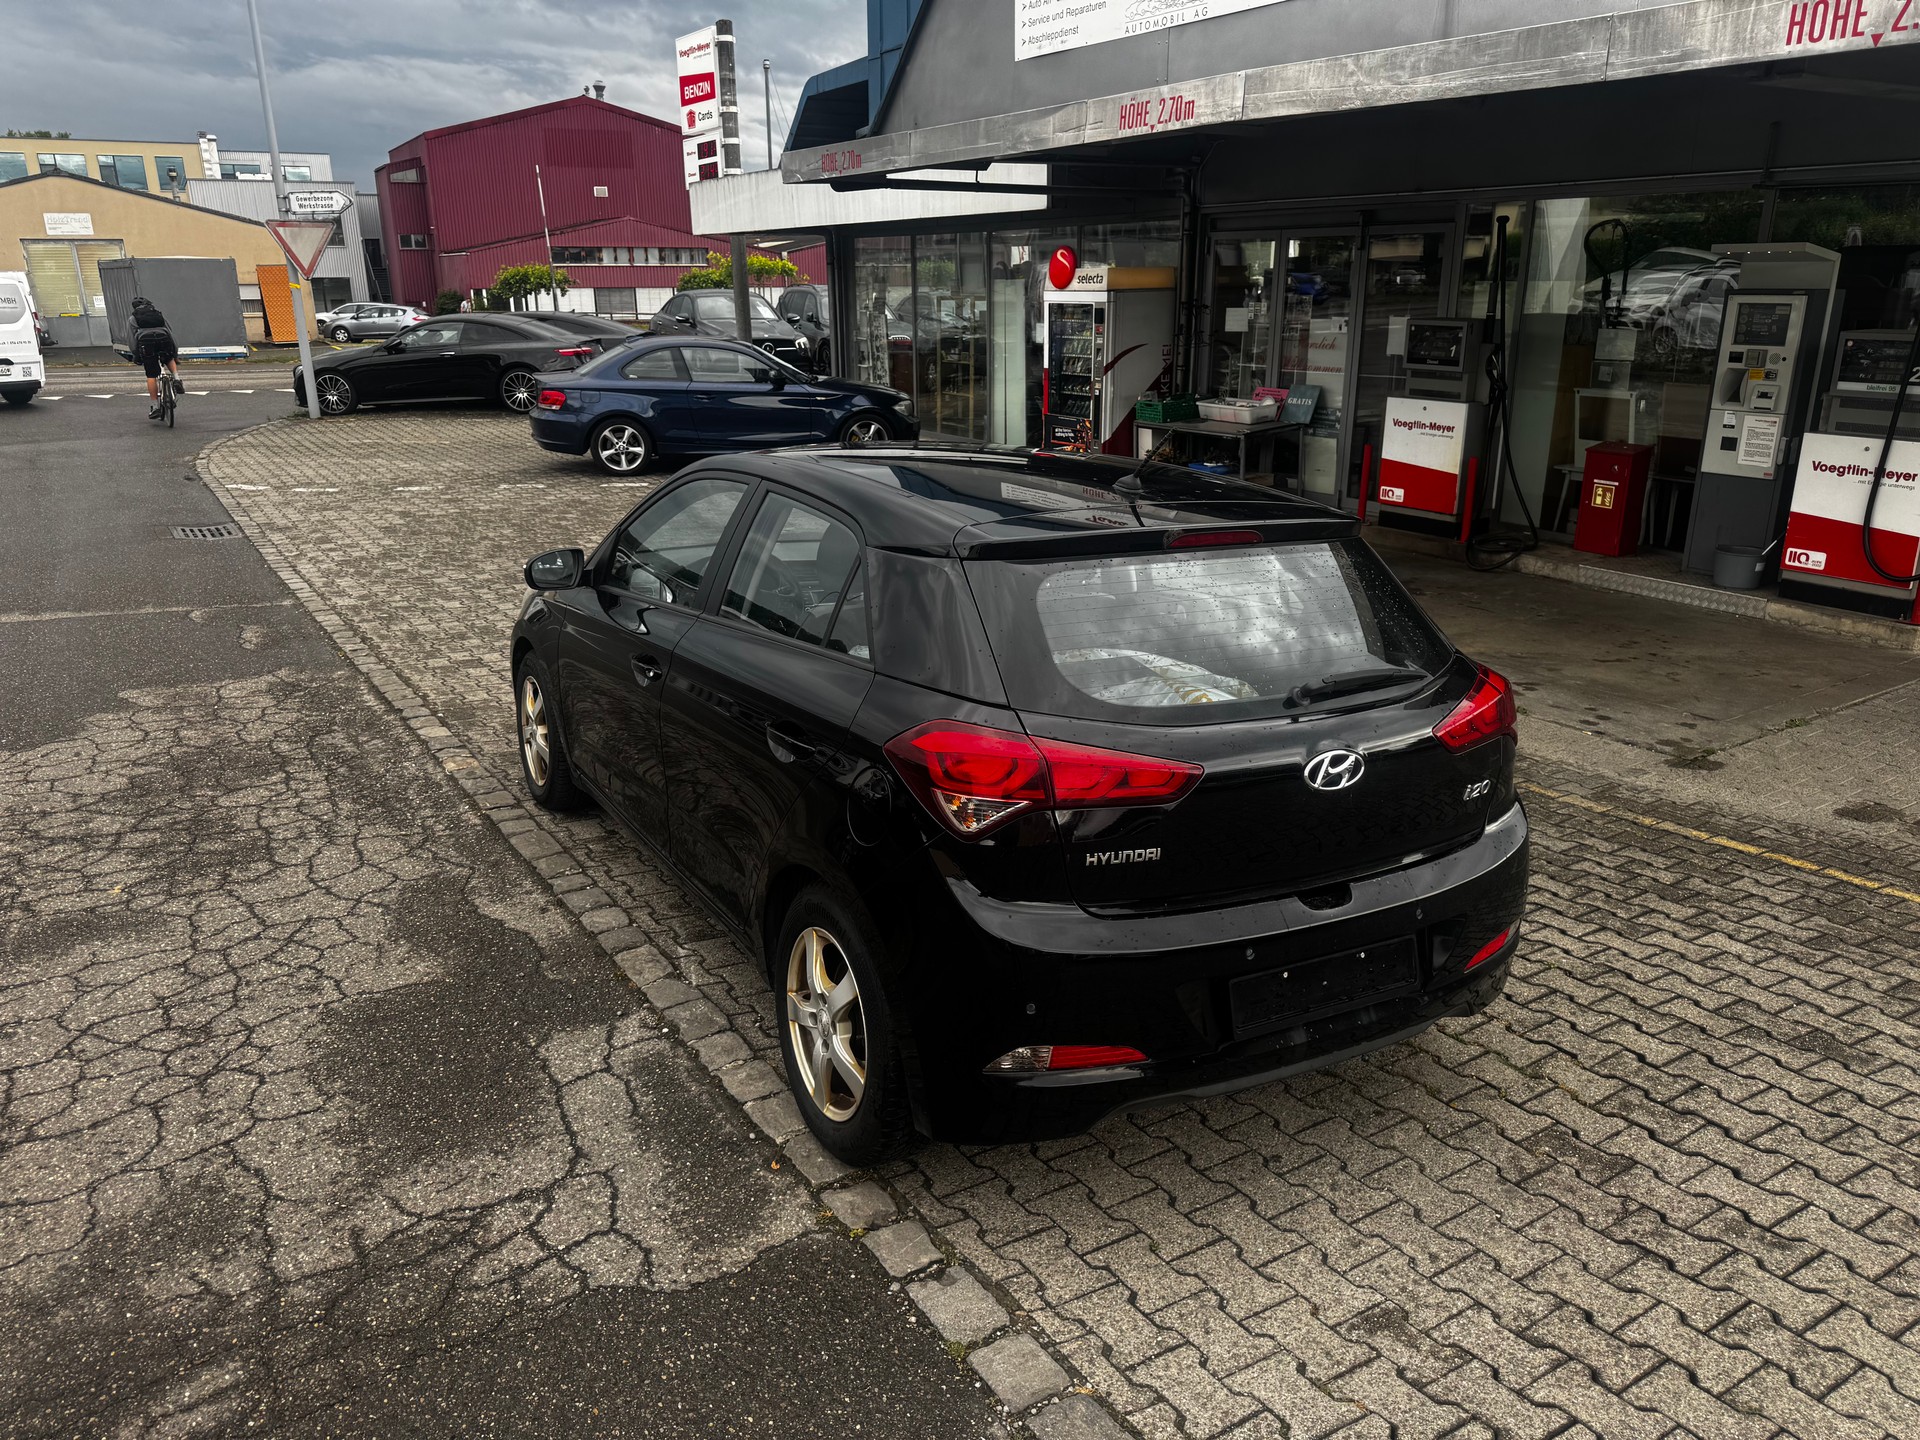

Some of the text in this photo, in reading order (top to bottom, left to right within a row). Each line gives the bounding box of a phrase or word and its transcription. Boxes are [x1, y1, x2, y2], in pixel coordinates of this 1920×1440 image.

[1028, 1, 1107, 27] Service und Reparaturen
[1125, 7, 1208, 34] AUTOMOBIL AG
[1028, 25, 1079, 45] Abschleppdienst
[684, 80, 711, 99] BENZIN
[698, 110, 713, 121] Cards
[1119, 97, 1150, 131] HÖHE
[1077, 273, 1104, 284] selecta
[1450, 345, 1456, 357] 1
[1908, 366, 1920, 383] 2
[1287, 397, 1312, 406] GRATIS
[1393, 418, 1455, 433] Voegtlin-Meyer
[1463, 780, 1491, 801] i20
[1086, 848, 1161, 866] HYUNDAI
